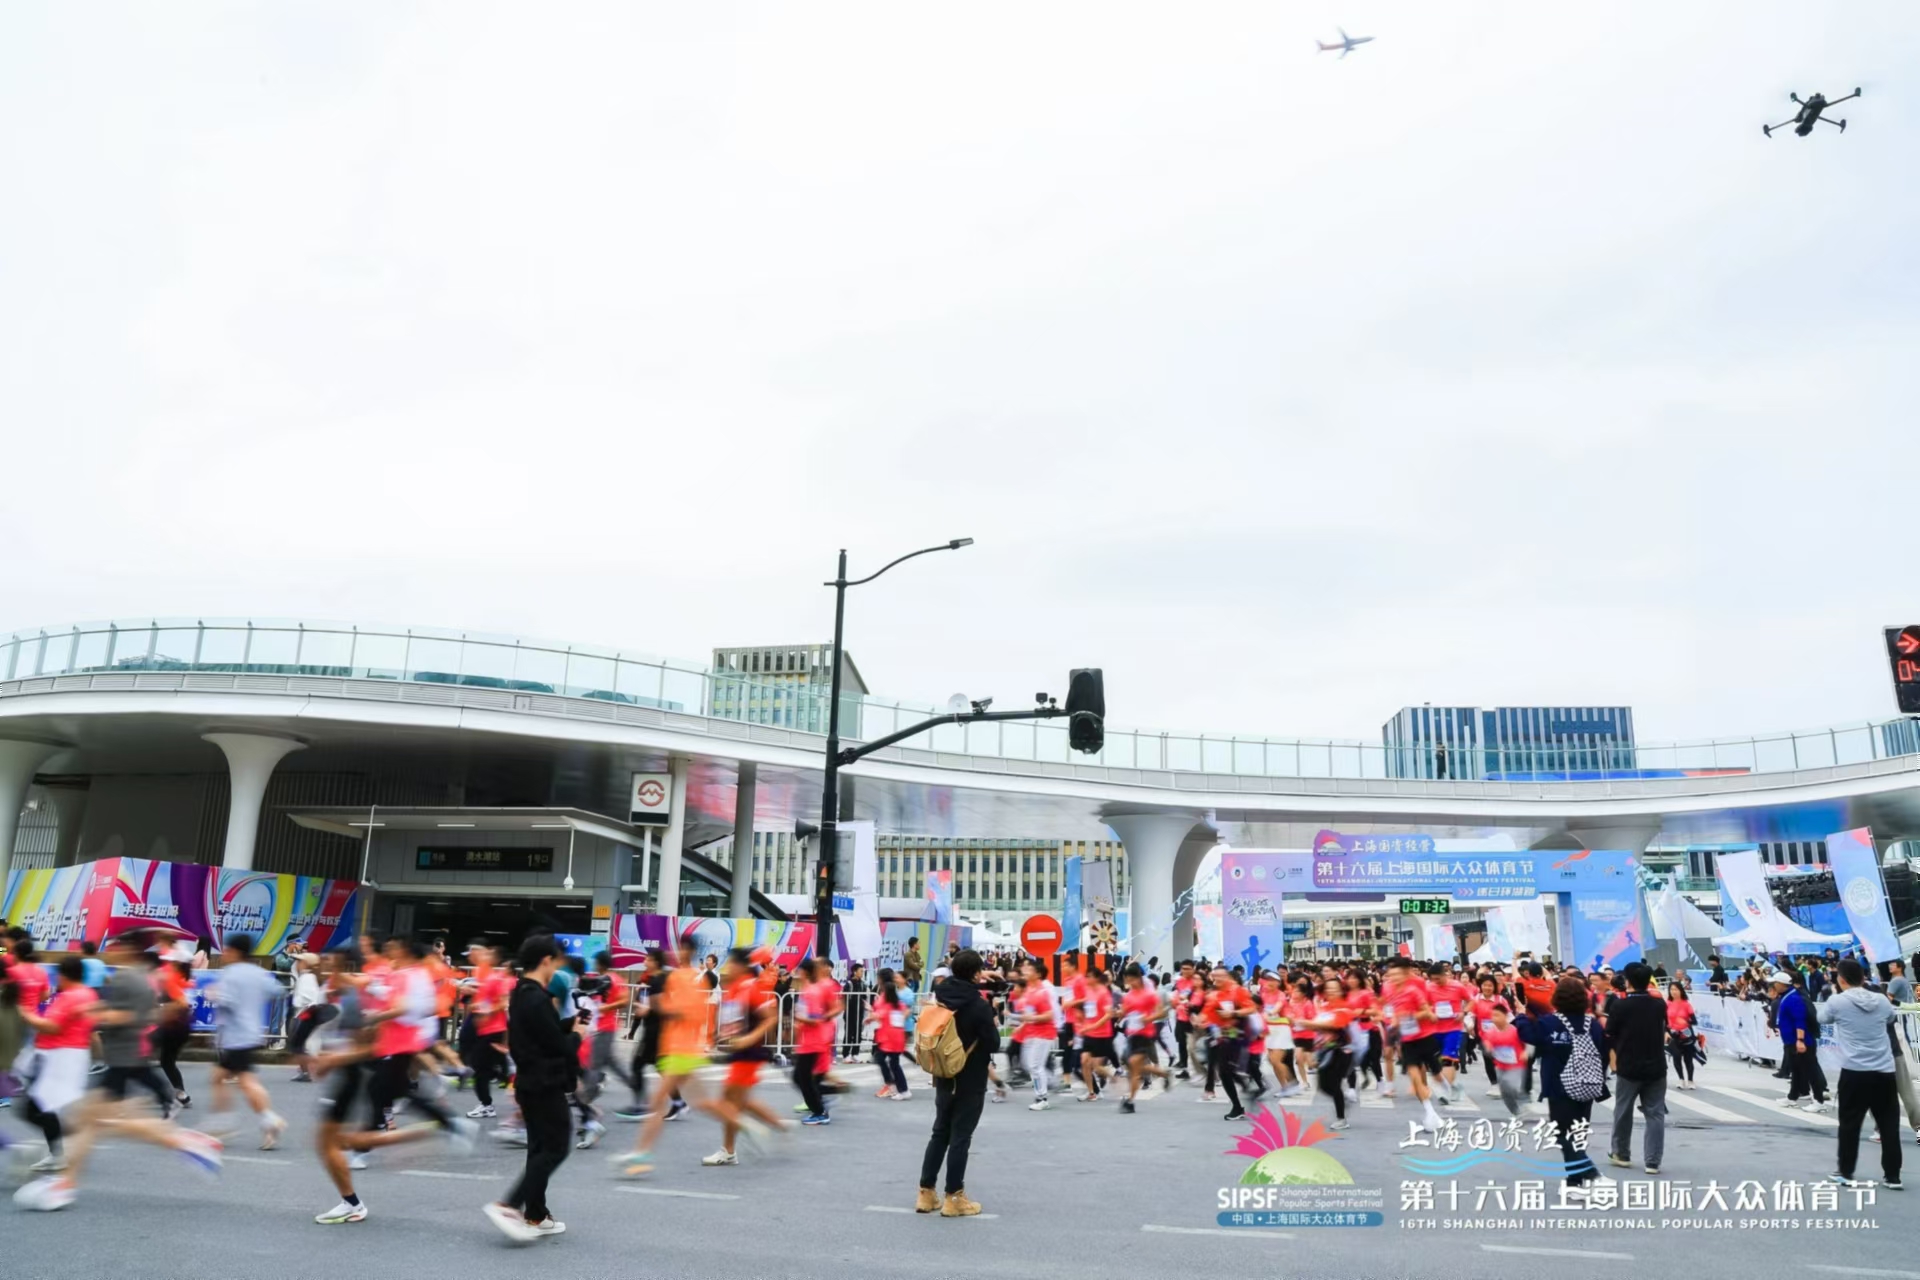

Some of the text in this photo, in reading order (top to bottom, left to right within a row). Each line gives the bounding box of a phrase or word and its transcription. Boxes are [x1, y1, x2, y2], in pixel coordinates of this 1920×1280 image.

[1352, 839, 1432, 853] 上海国资经营
[1317, 860, 1534, 876] 第十六届上海国际大众体育节
[1402, 901, 1447, 913] 0:01:32
